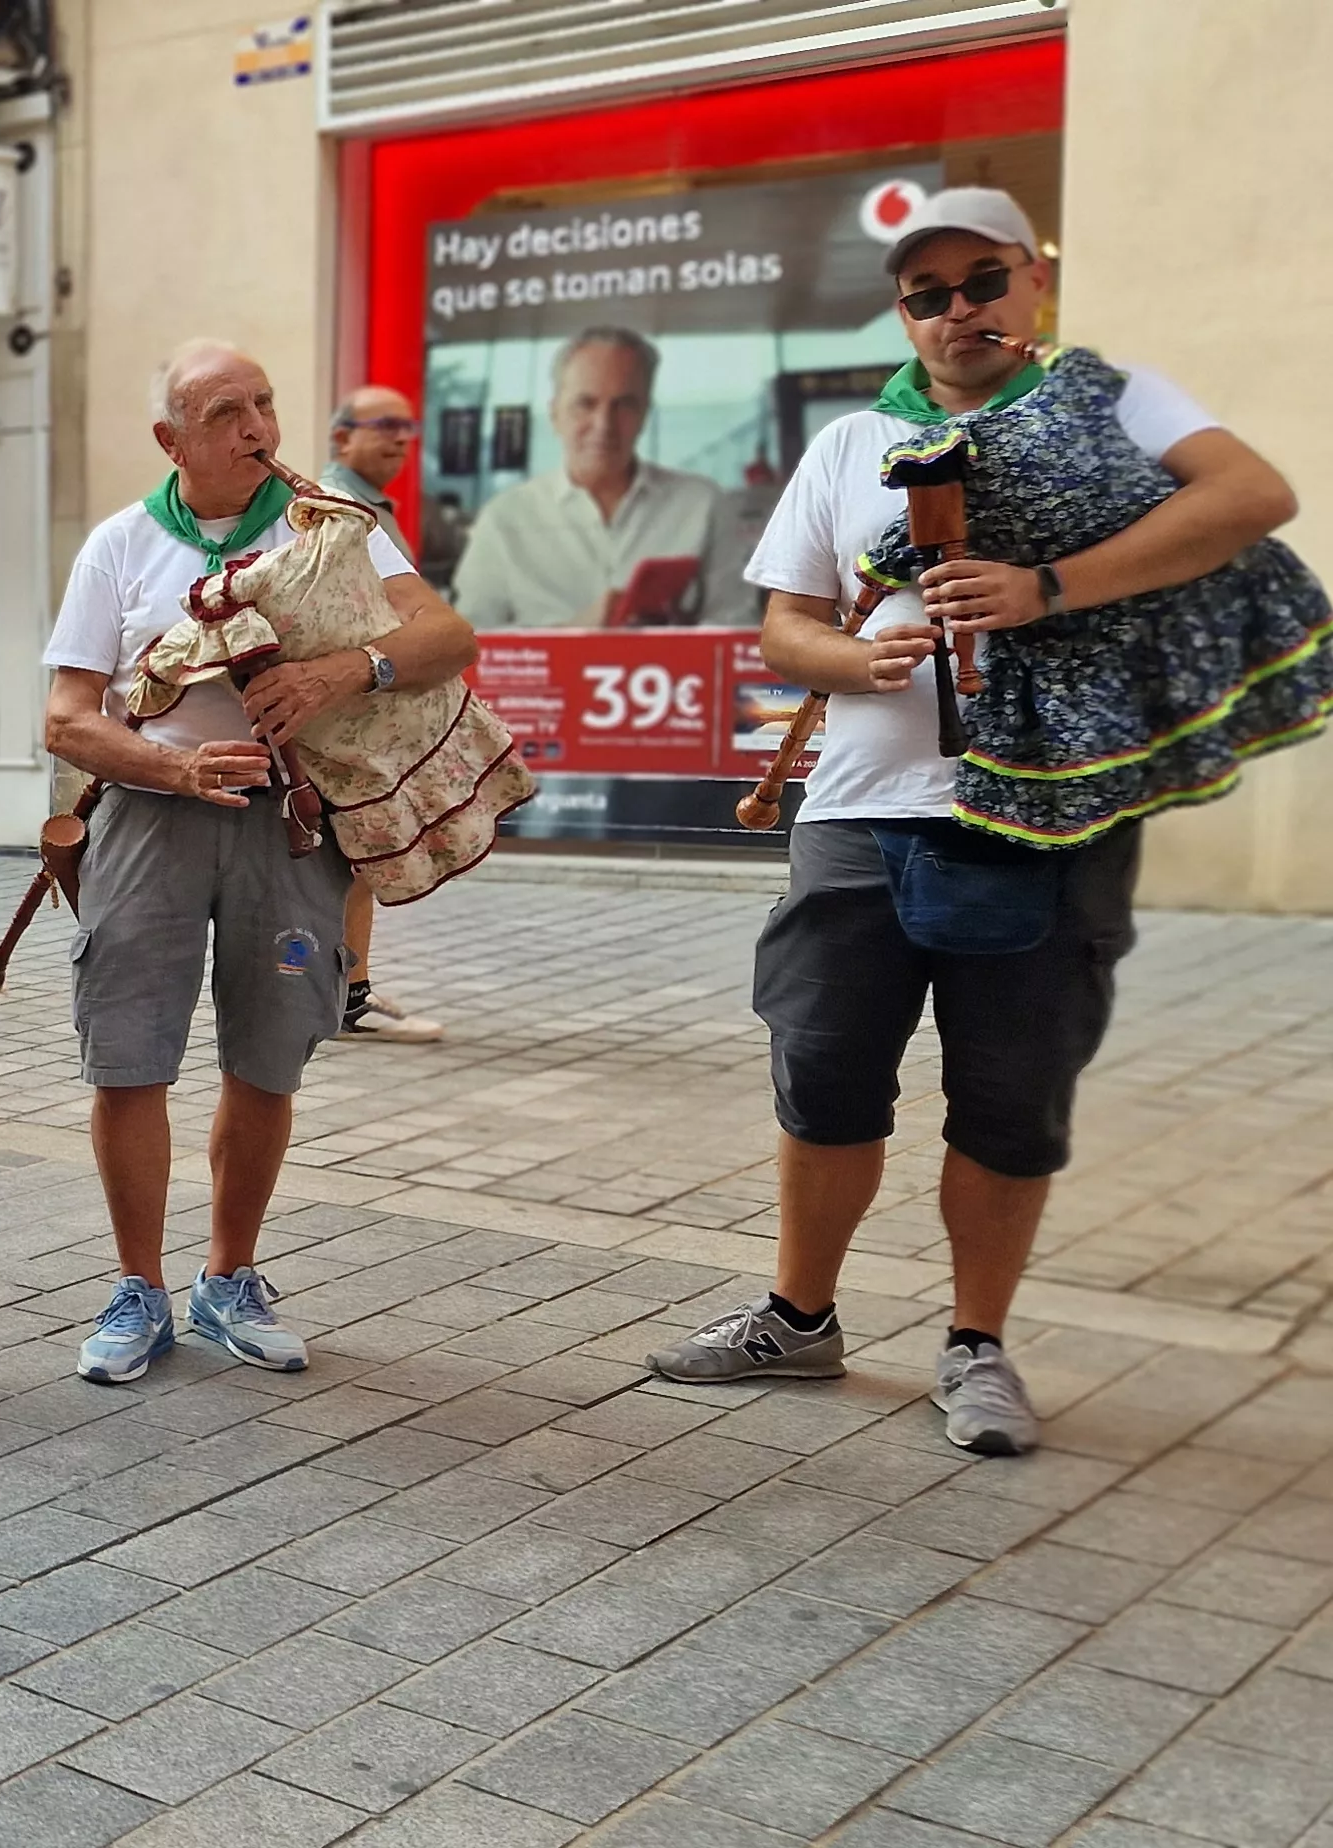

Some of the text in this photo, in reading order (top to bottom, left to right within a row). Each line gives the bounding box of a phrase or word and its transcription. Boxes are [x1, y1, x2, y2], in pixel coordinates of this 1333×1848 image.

[434, 210, 703, 270] Hay decisiones
[432, 250, 783, 320] que se toman solas
[581, 664, 704, 730] 39€
